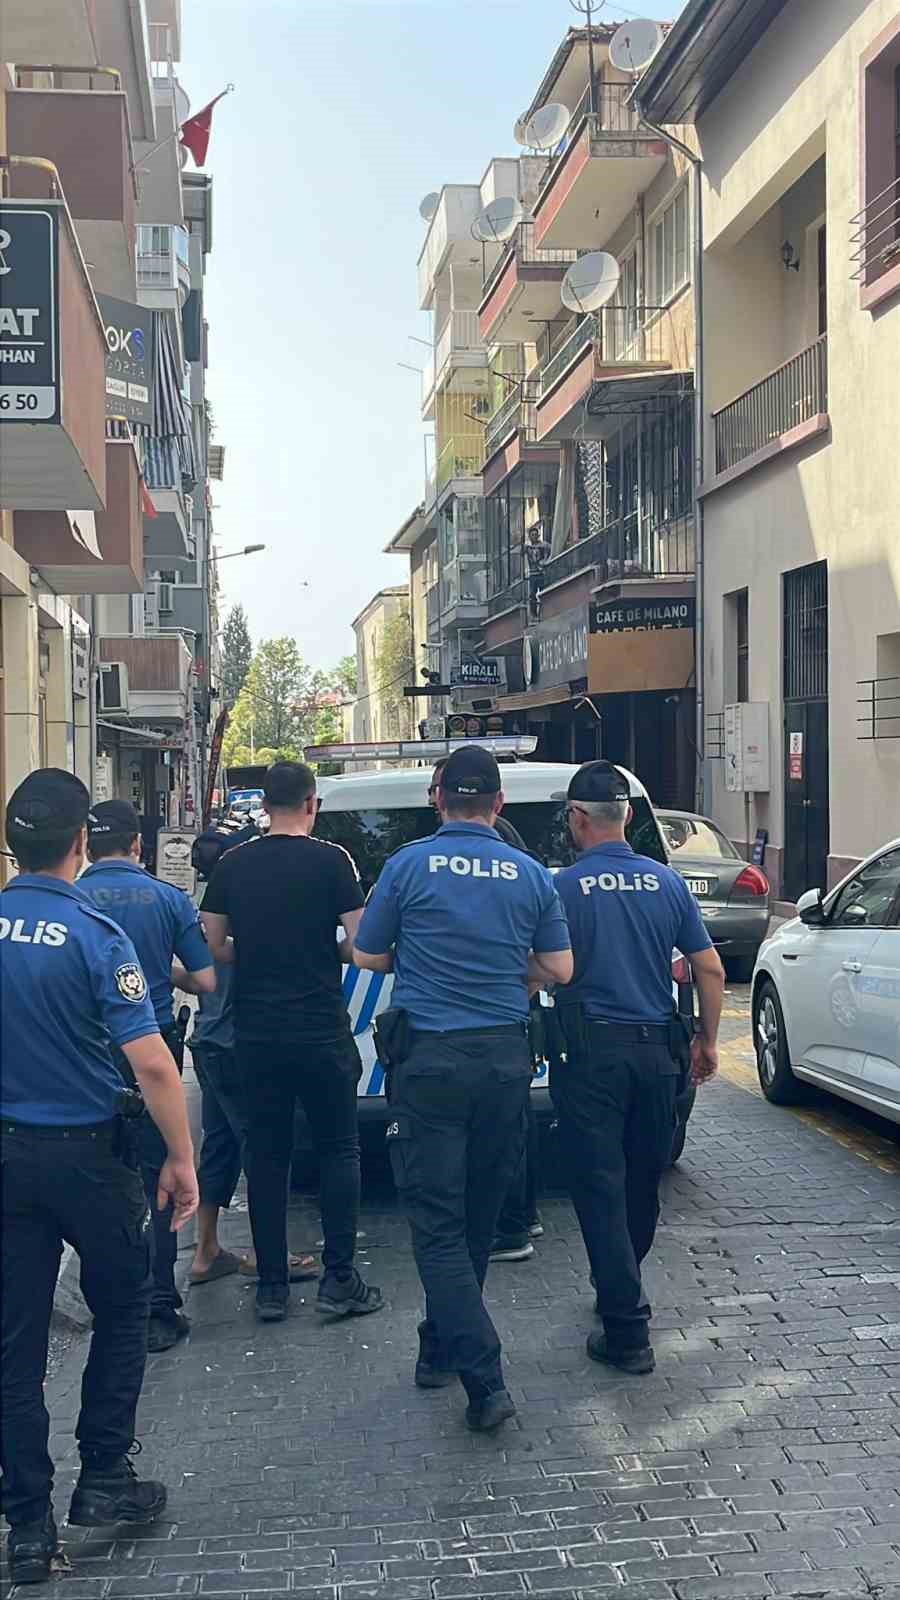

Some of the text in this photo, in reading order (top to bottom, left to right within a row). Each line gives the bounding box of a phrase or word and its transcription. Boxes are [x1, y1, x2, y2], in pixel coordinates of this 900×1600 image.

[15, 394, 38, 410] 50
[596, 610, 625, 624] CAFE
[626, 607, 641, 622] DE
